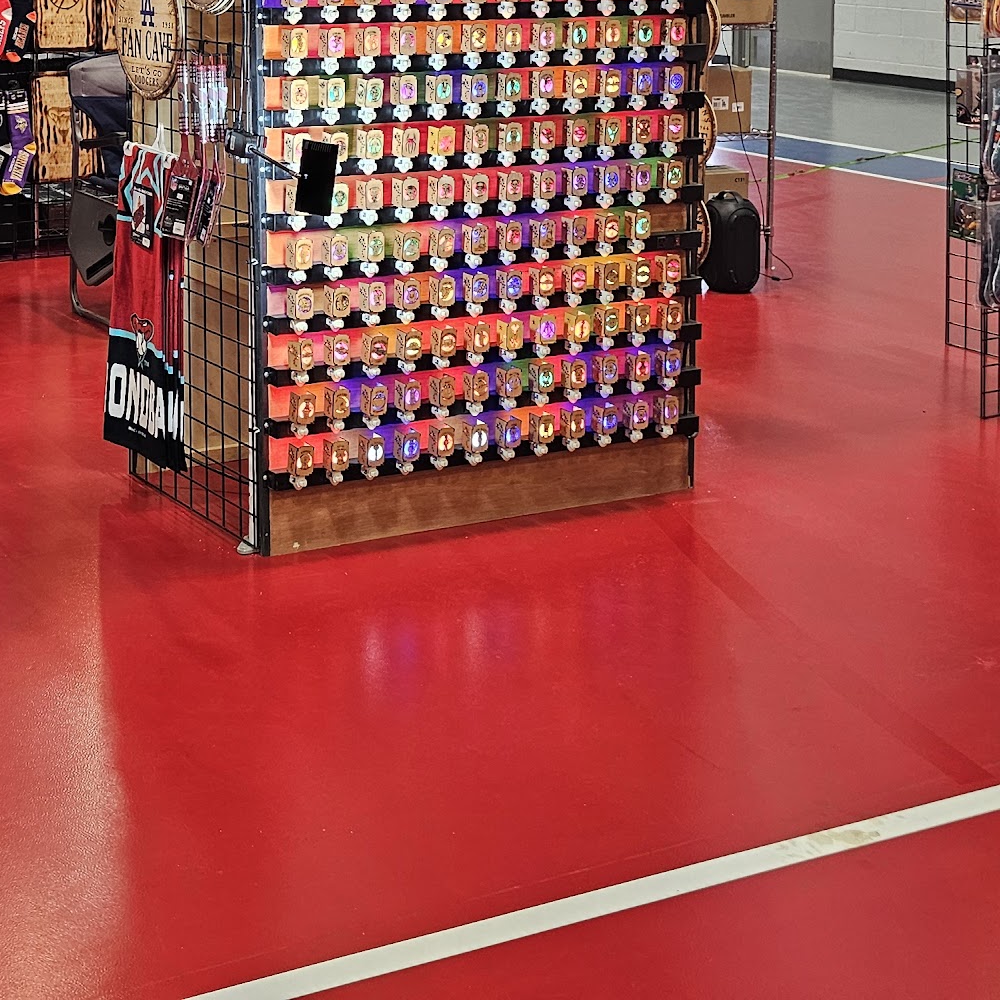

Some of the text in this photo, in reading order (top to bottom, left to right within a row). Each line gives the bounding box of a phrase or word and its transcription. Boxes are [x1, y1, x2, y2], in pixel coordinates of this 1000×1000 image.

[118, 16, 134, 24] SINCE
[121, 27, 173, 64] FAN CAVE
[132, 66, 163, 78] LET'S GO
